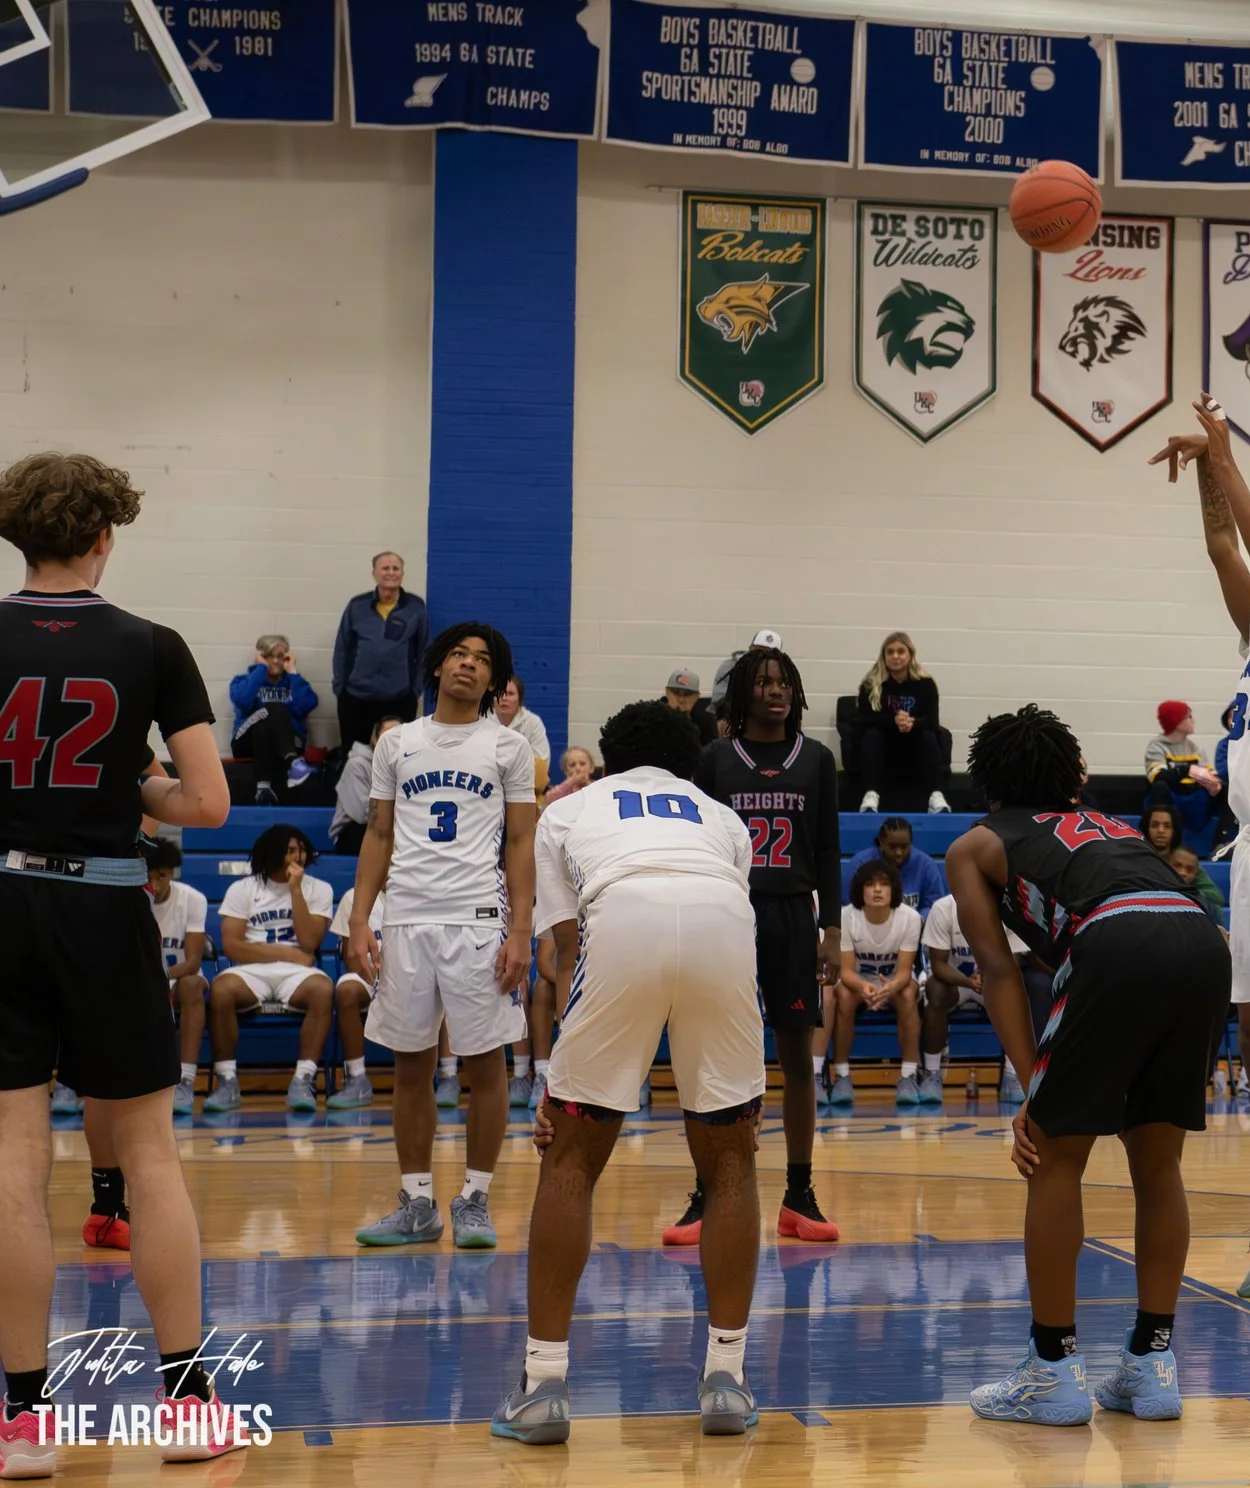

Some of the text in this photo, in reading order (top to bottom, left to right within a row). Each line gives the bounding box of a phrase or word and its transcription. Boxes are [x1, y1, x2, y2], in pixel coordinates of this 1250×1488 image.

[188, 8, 281, 31] CHAMPIONS
[427, 2, 524, 27] MENS TRACK
[660, 15, 802, 54] BOYS BASKETBALL
[914, 28, 1056, 64] BOYS BASKETBALL
[414, 42, 535, 69] 1994 6A STATE
[680, 47, 754, 78] 6A STATE
[933, 57, 1008, 89] 6A STATE
[1184, 61, 1224, 89] MENS
[486, 86, 549, 112] CHAMPS
[641, 70, 818, 115] SPORTSMANSHIP AWARD
[944, 85, 1026, 117] CHAMPIONS
[712, 107, 748, 136] 1999
[964, 115, 1004, 144] 2000
[1173, 101, 1208, 128] 2001
[1219, 102, 1239, 129] 6A
[673, 133, 683, 145] IN
[685, 135, 721, 147] MEMORY
[920, 149, 929, 160] IN
[934, 150, 970, 162] MEMORY
[870, 212, 985, 242] DE SOTO
[1083, 223, 1161, 250] NSING
[697, 230, 810, 265] Bobcats
[873, 237, 981, 270] Wildcats
[1063, 249, 1149, 283] Lions
[0, 676, 119, 789] 42
[402, 770, 494, 800] PIONEERS
[730, 792, 806, 812] HEIGHTS
[428, 801, 459, 842] 3
[748, 817, 793, 868] 22
